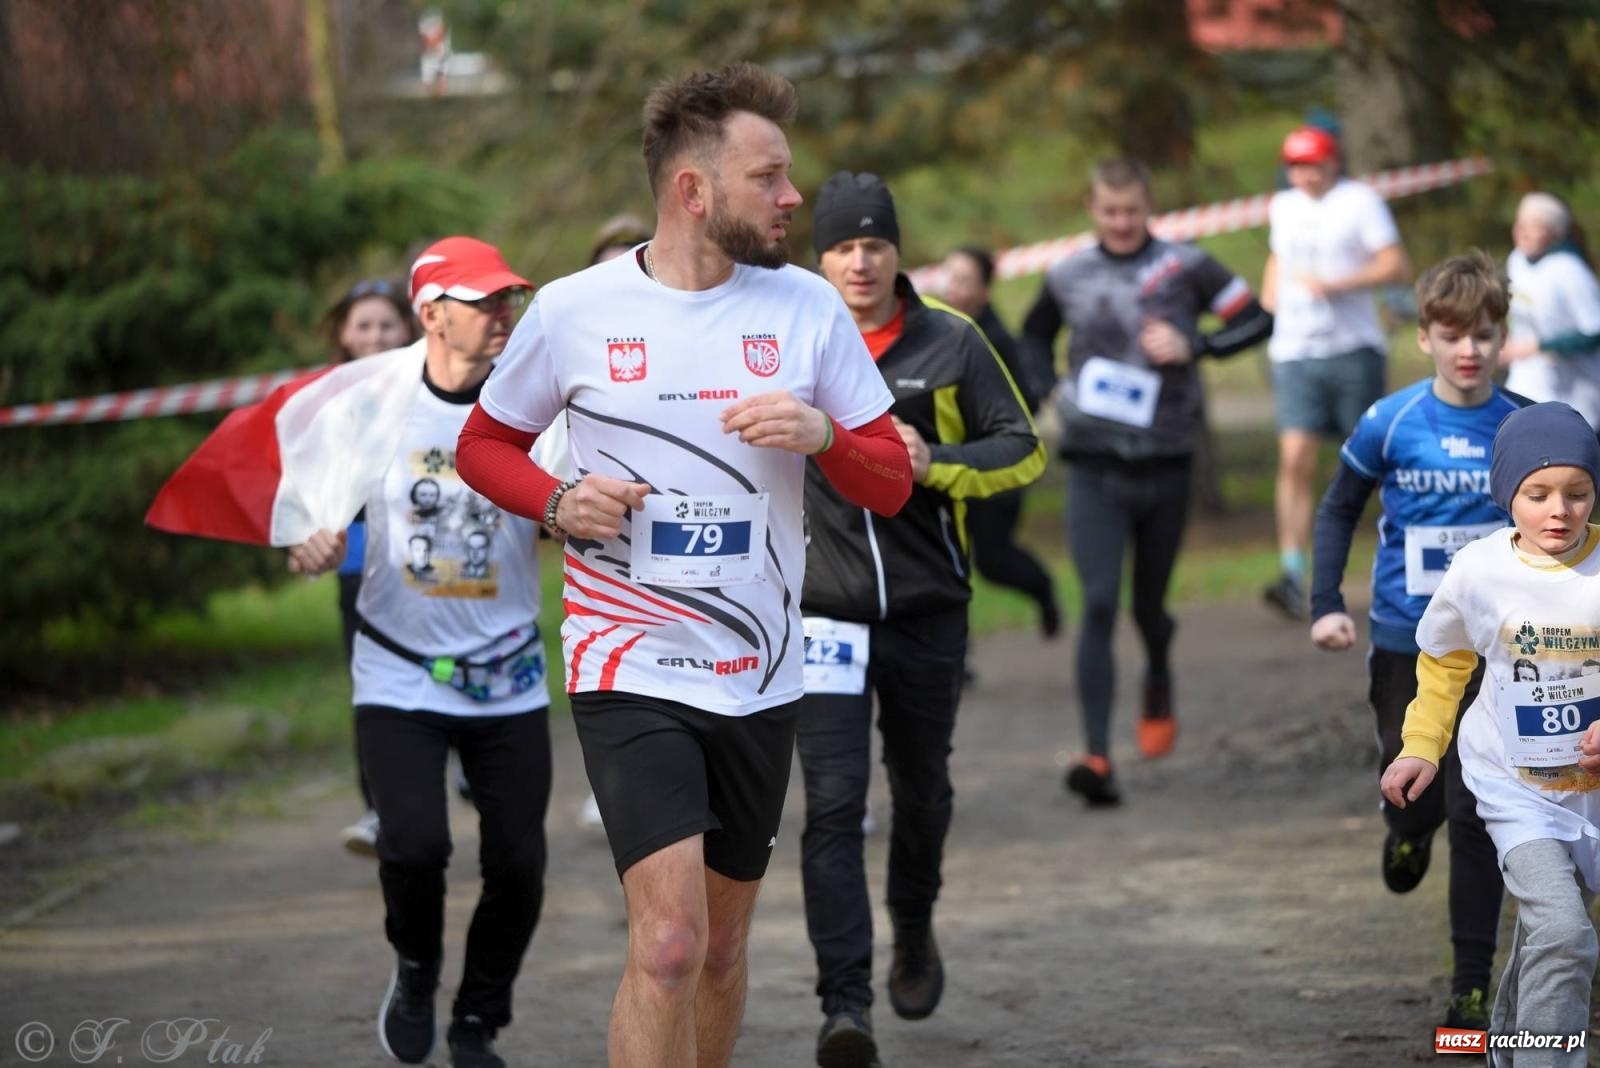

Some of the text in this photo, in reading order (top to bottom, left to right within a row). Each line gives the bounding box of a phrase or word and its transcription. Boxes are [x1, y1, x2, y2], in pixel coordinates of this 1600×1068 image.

[693, 507, 731, 518] WILCZYM
[681, 524, 724, 554] 79
[1542, 627, 1572, 637] TROPEM
[1544, 636, 1600, 650] WILCZYM
[1548, 687, 1584, 700] WILCZYM
[1541, 704, 1581, 734] 80
